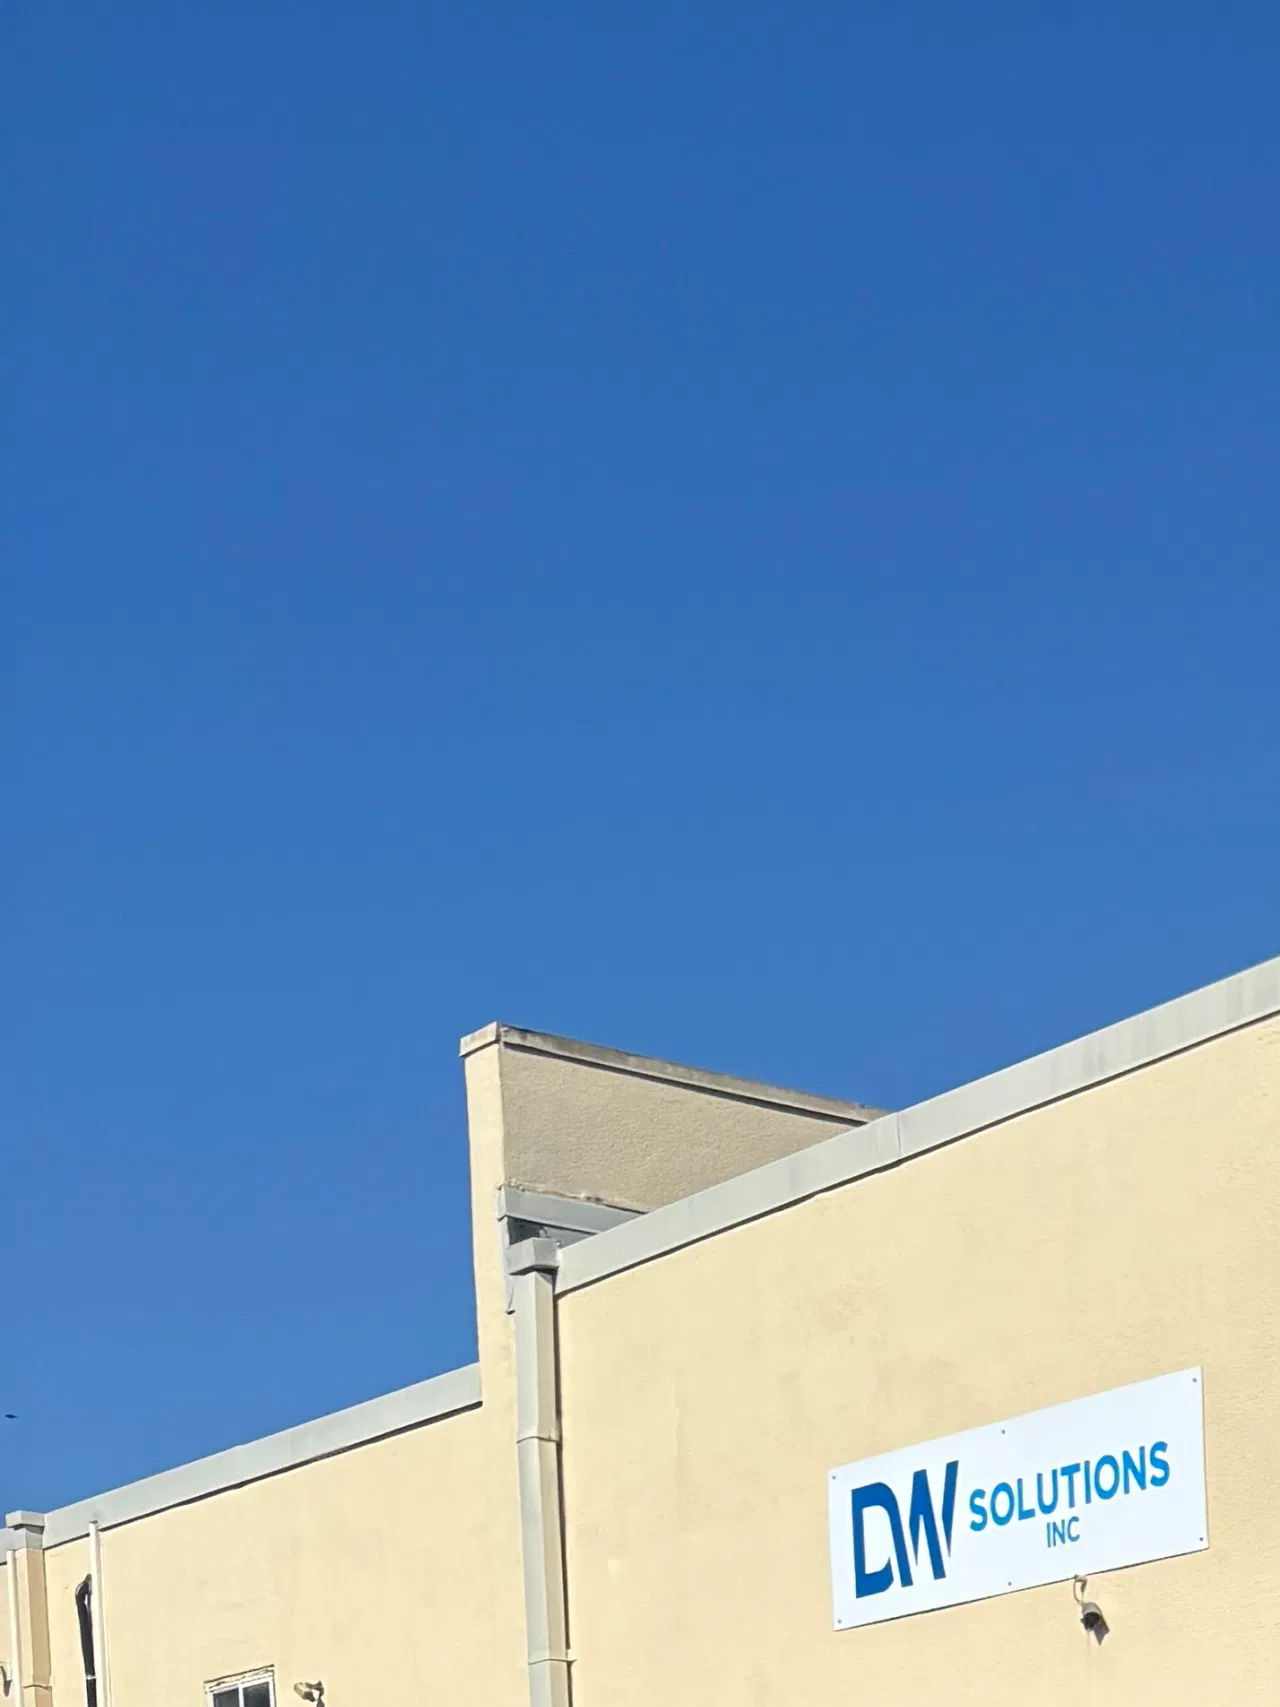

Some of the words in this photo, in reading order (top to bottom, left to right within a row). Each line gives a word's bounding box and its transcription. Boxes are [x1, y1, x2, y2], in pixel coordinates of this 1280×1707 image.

[850, 1459, 960, 1600] DW
[968, 1440, 1171, 1532] SOLUTIONS
[1046, 1516, 1081, 1548] INC
